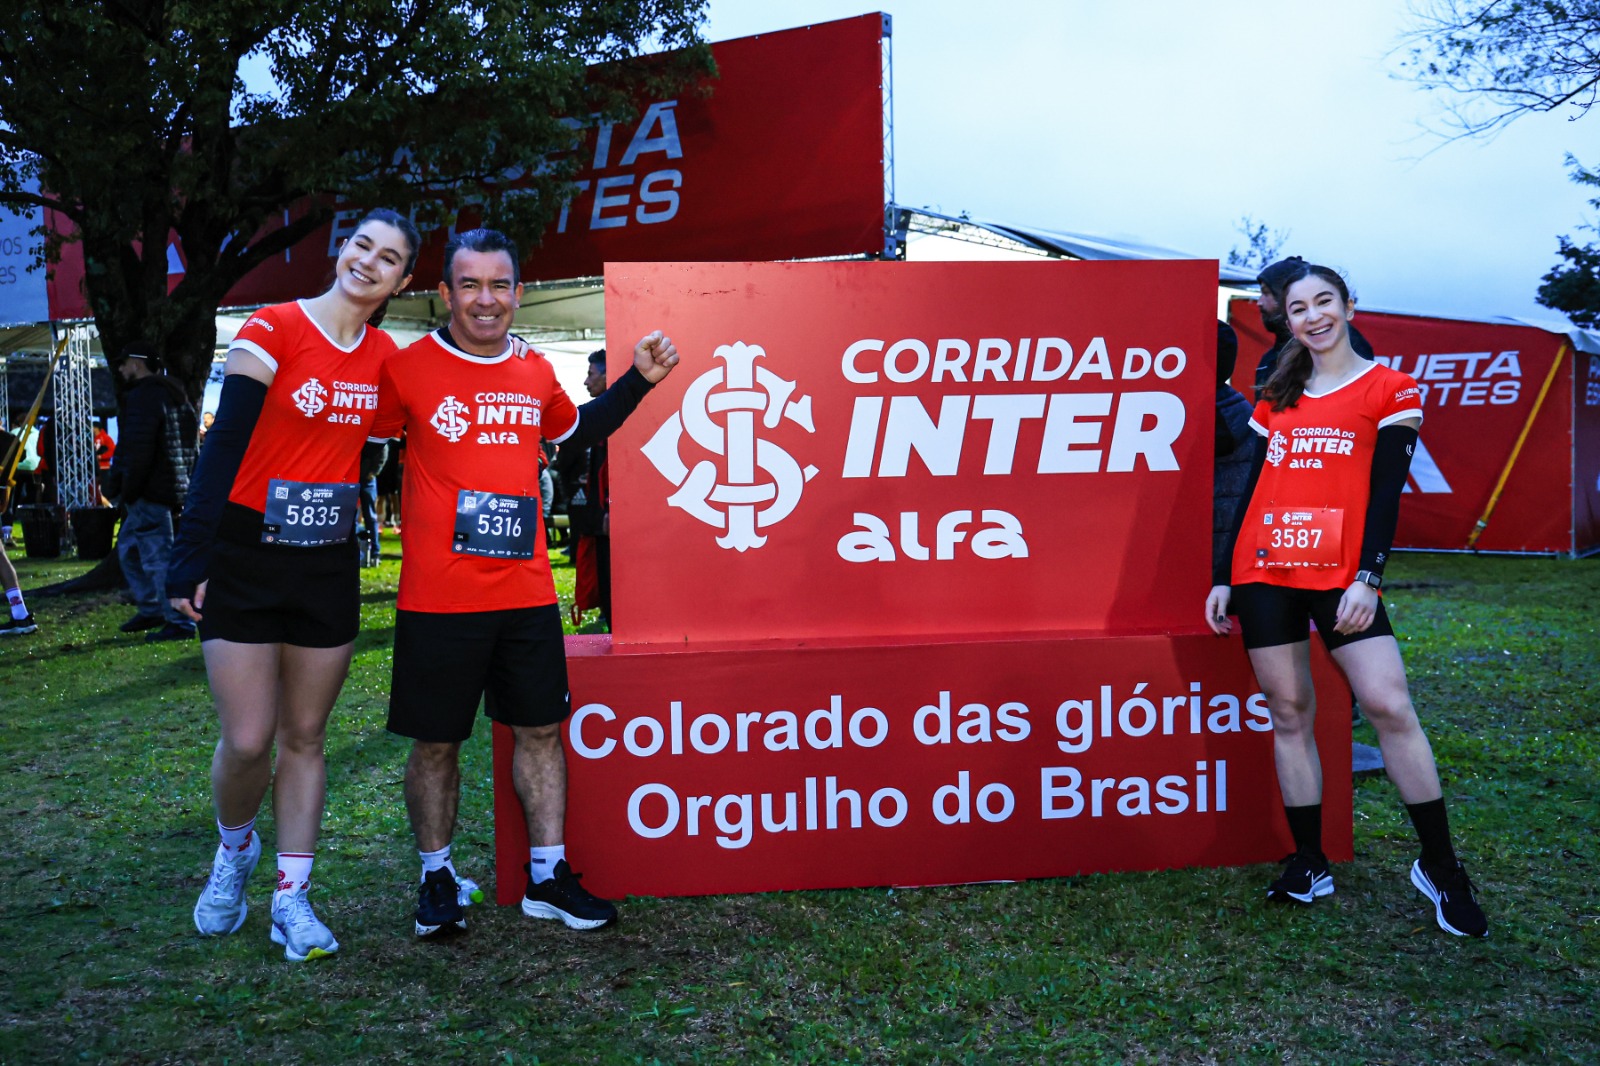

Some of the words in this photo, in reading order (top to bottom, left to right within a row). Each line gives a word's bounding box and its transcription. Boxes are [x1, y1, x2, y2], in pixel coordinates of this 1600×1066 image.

[841, 336, 1113, 384] CORRIDA
[1121, 346, 1187, 380] DO
[333, 381, 374, 392] CORRIDA
[475, 392, 533, 404] CORRIDA
[532, 398, 541, 407] DO
[328, 413, 361, 425] alfa
[477, 405, 541, 427] INTER
[477, 432, 520, 445] alfa
[842, 391, 1187, 478] INTER
[1292, 428, 1340, 437] CORRIDA
[1342, 431, 1355, 439] DO
[1291, 438, 1354, 456] INTER
[1289, 459, 1323, 469] alfa
[286, 505, 341, 526] 5835
[477, 514, 522, 537] 5316
[836, 509, 1029, 563] alfa
[1271, 528, 1322, 548] 3587
[569, 694, 889, 759] Colorado
[912, 690, 1032, 746] das
[1055, 681, 1275, 754] glórias
[627, 776, 908, 849] Orgulho
[931, 770, 1016, 825] do
[1041, 759, 1227, 820] Brasil
